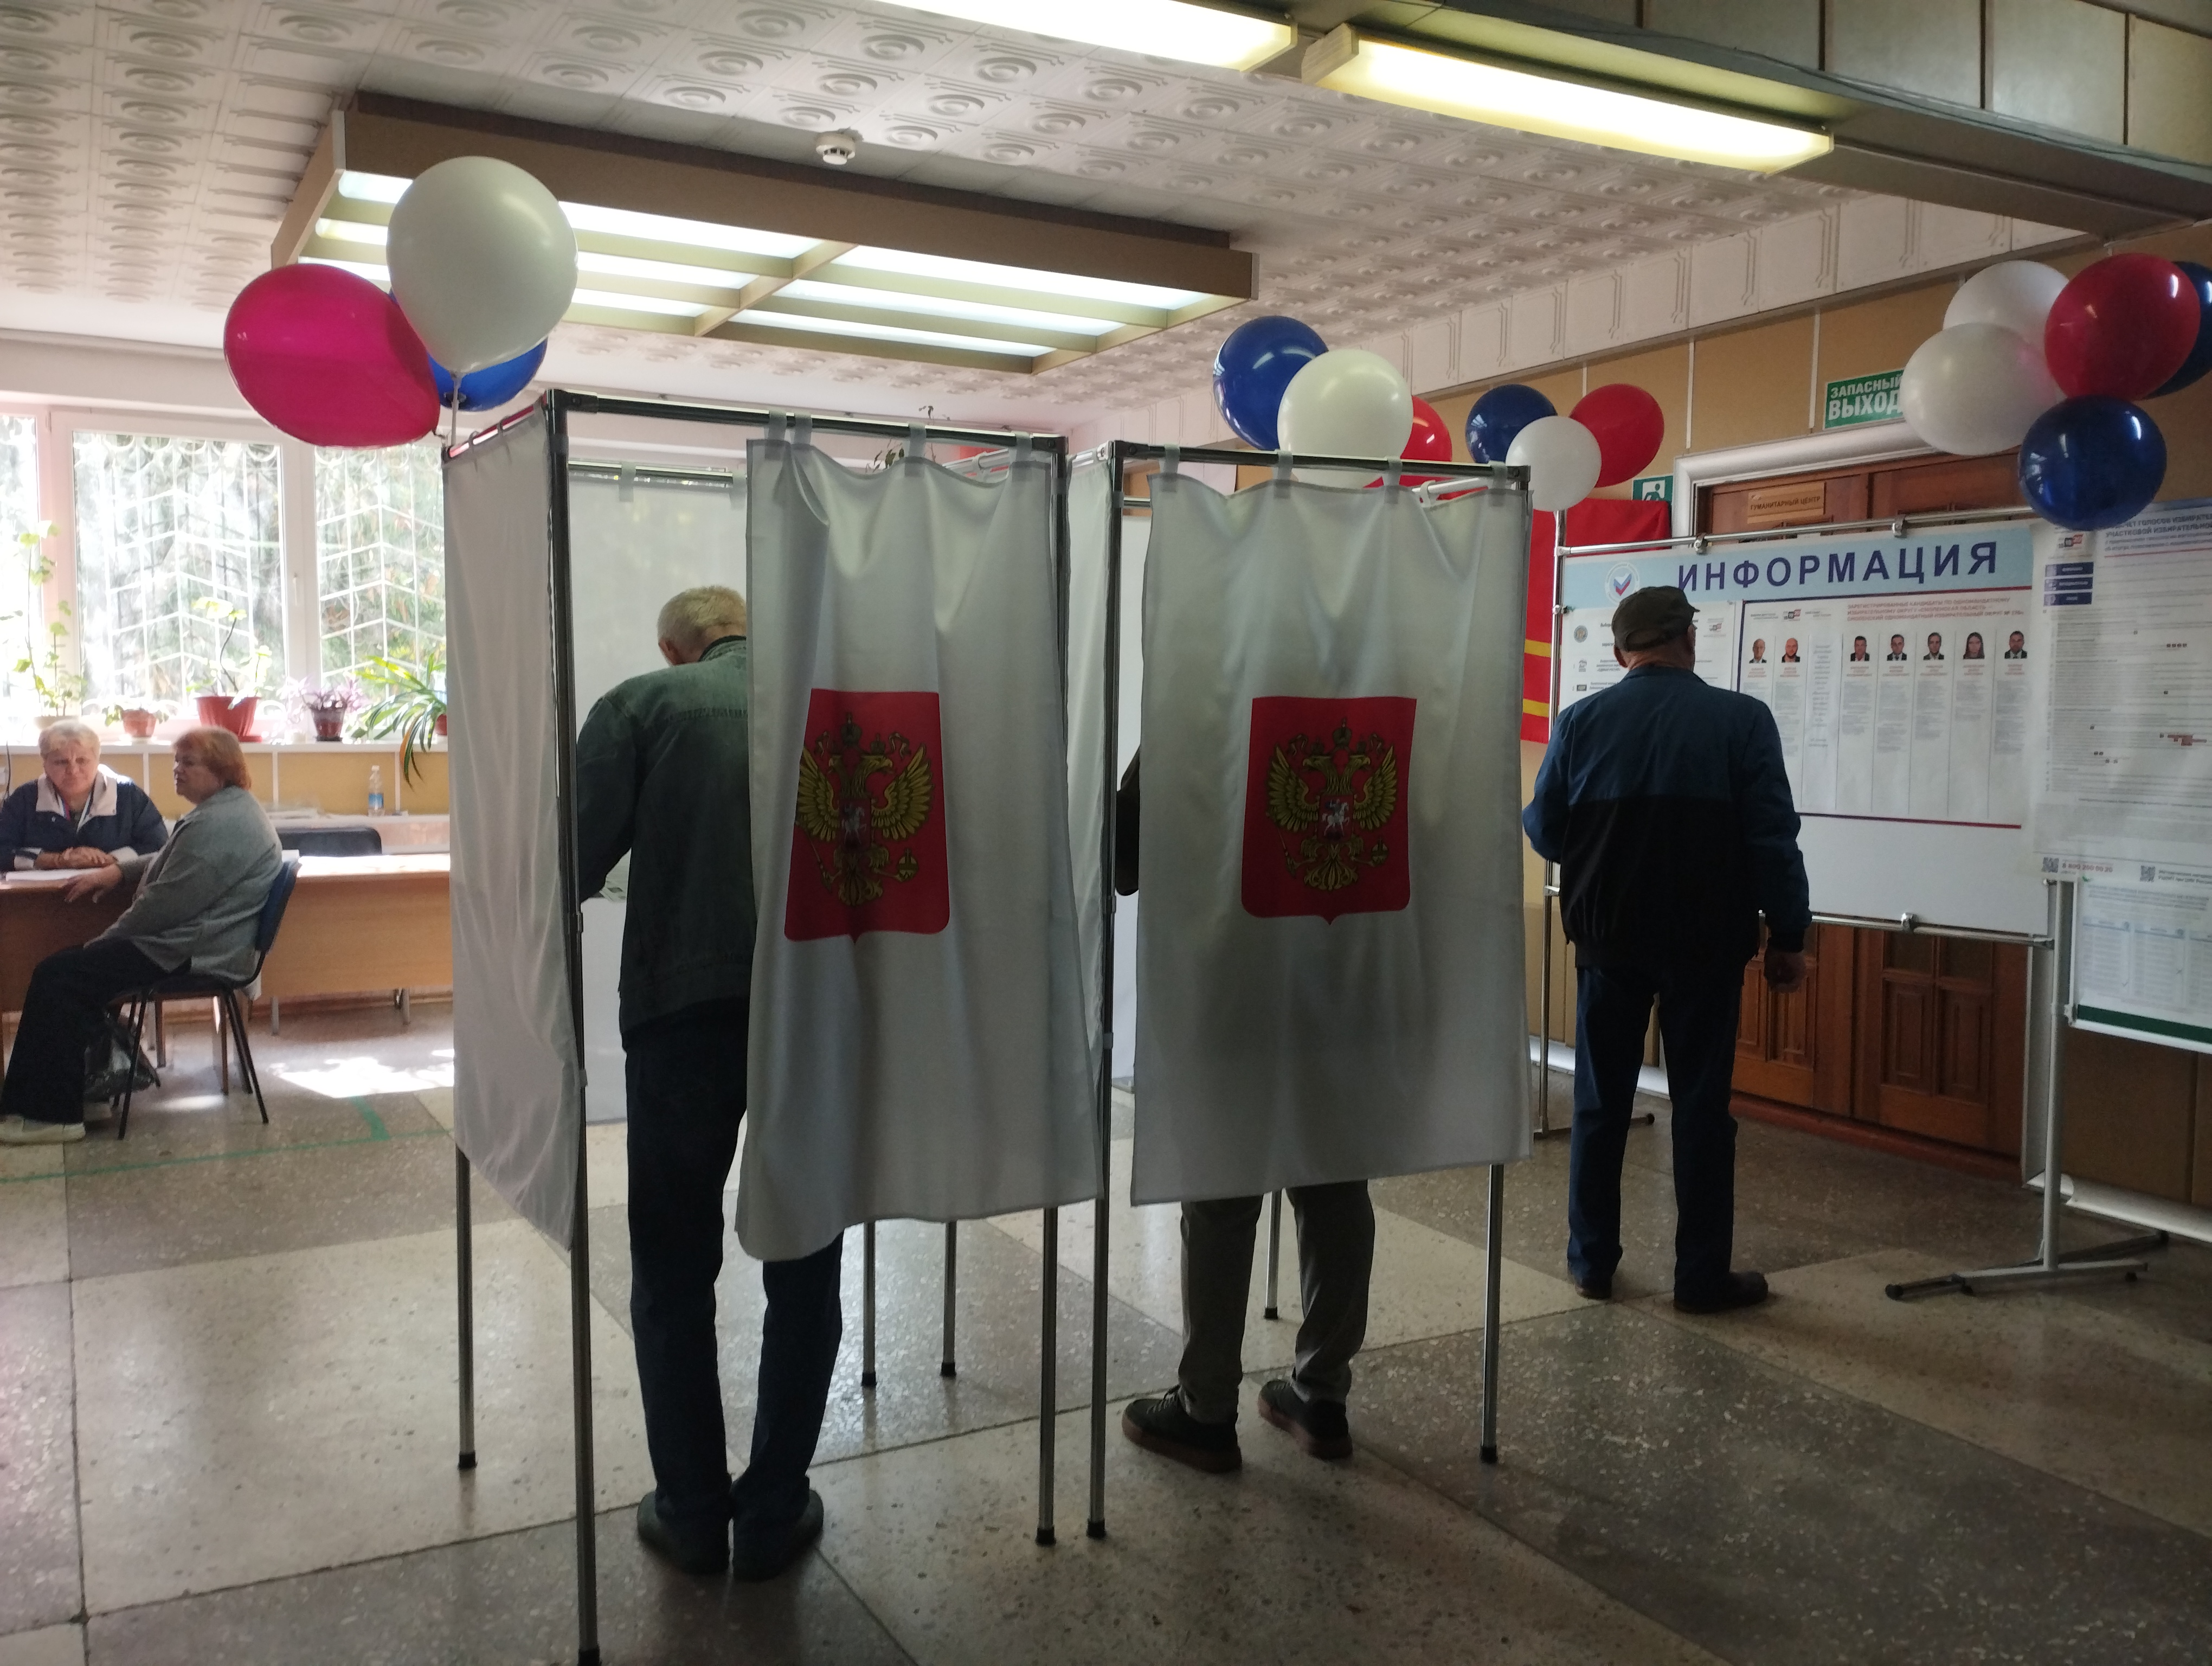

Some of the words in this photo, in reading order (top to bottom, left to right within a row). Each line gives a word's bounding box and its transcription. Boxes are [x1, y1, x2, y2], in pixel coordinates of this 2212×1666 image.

[1830, 373, 1901, 399] ЗАПАСНЫЙ
[1828, 389, 1903, 420] ВЫХОД
[1750, 498, 1799, 510] ГУМАНИТАРНЫЙ
[1801, 496, 1821, 505] ЦЕНТР
[1679, 541, 1997, 592] ИНФОРМАЦИЯ
